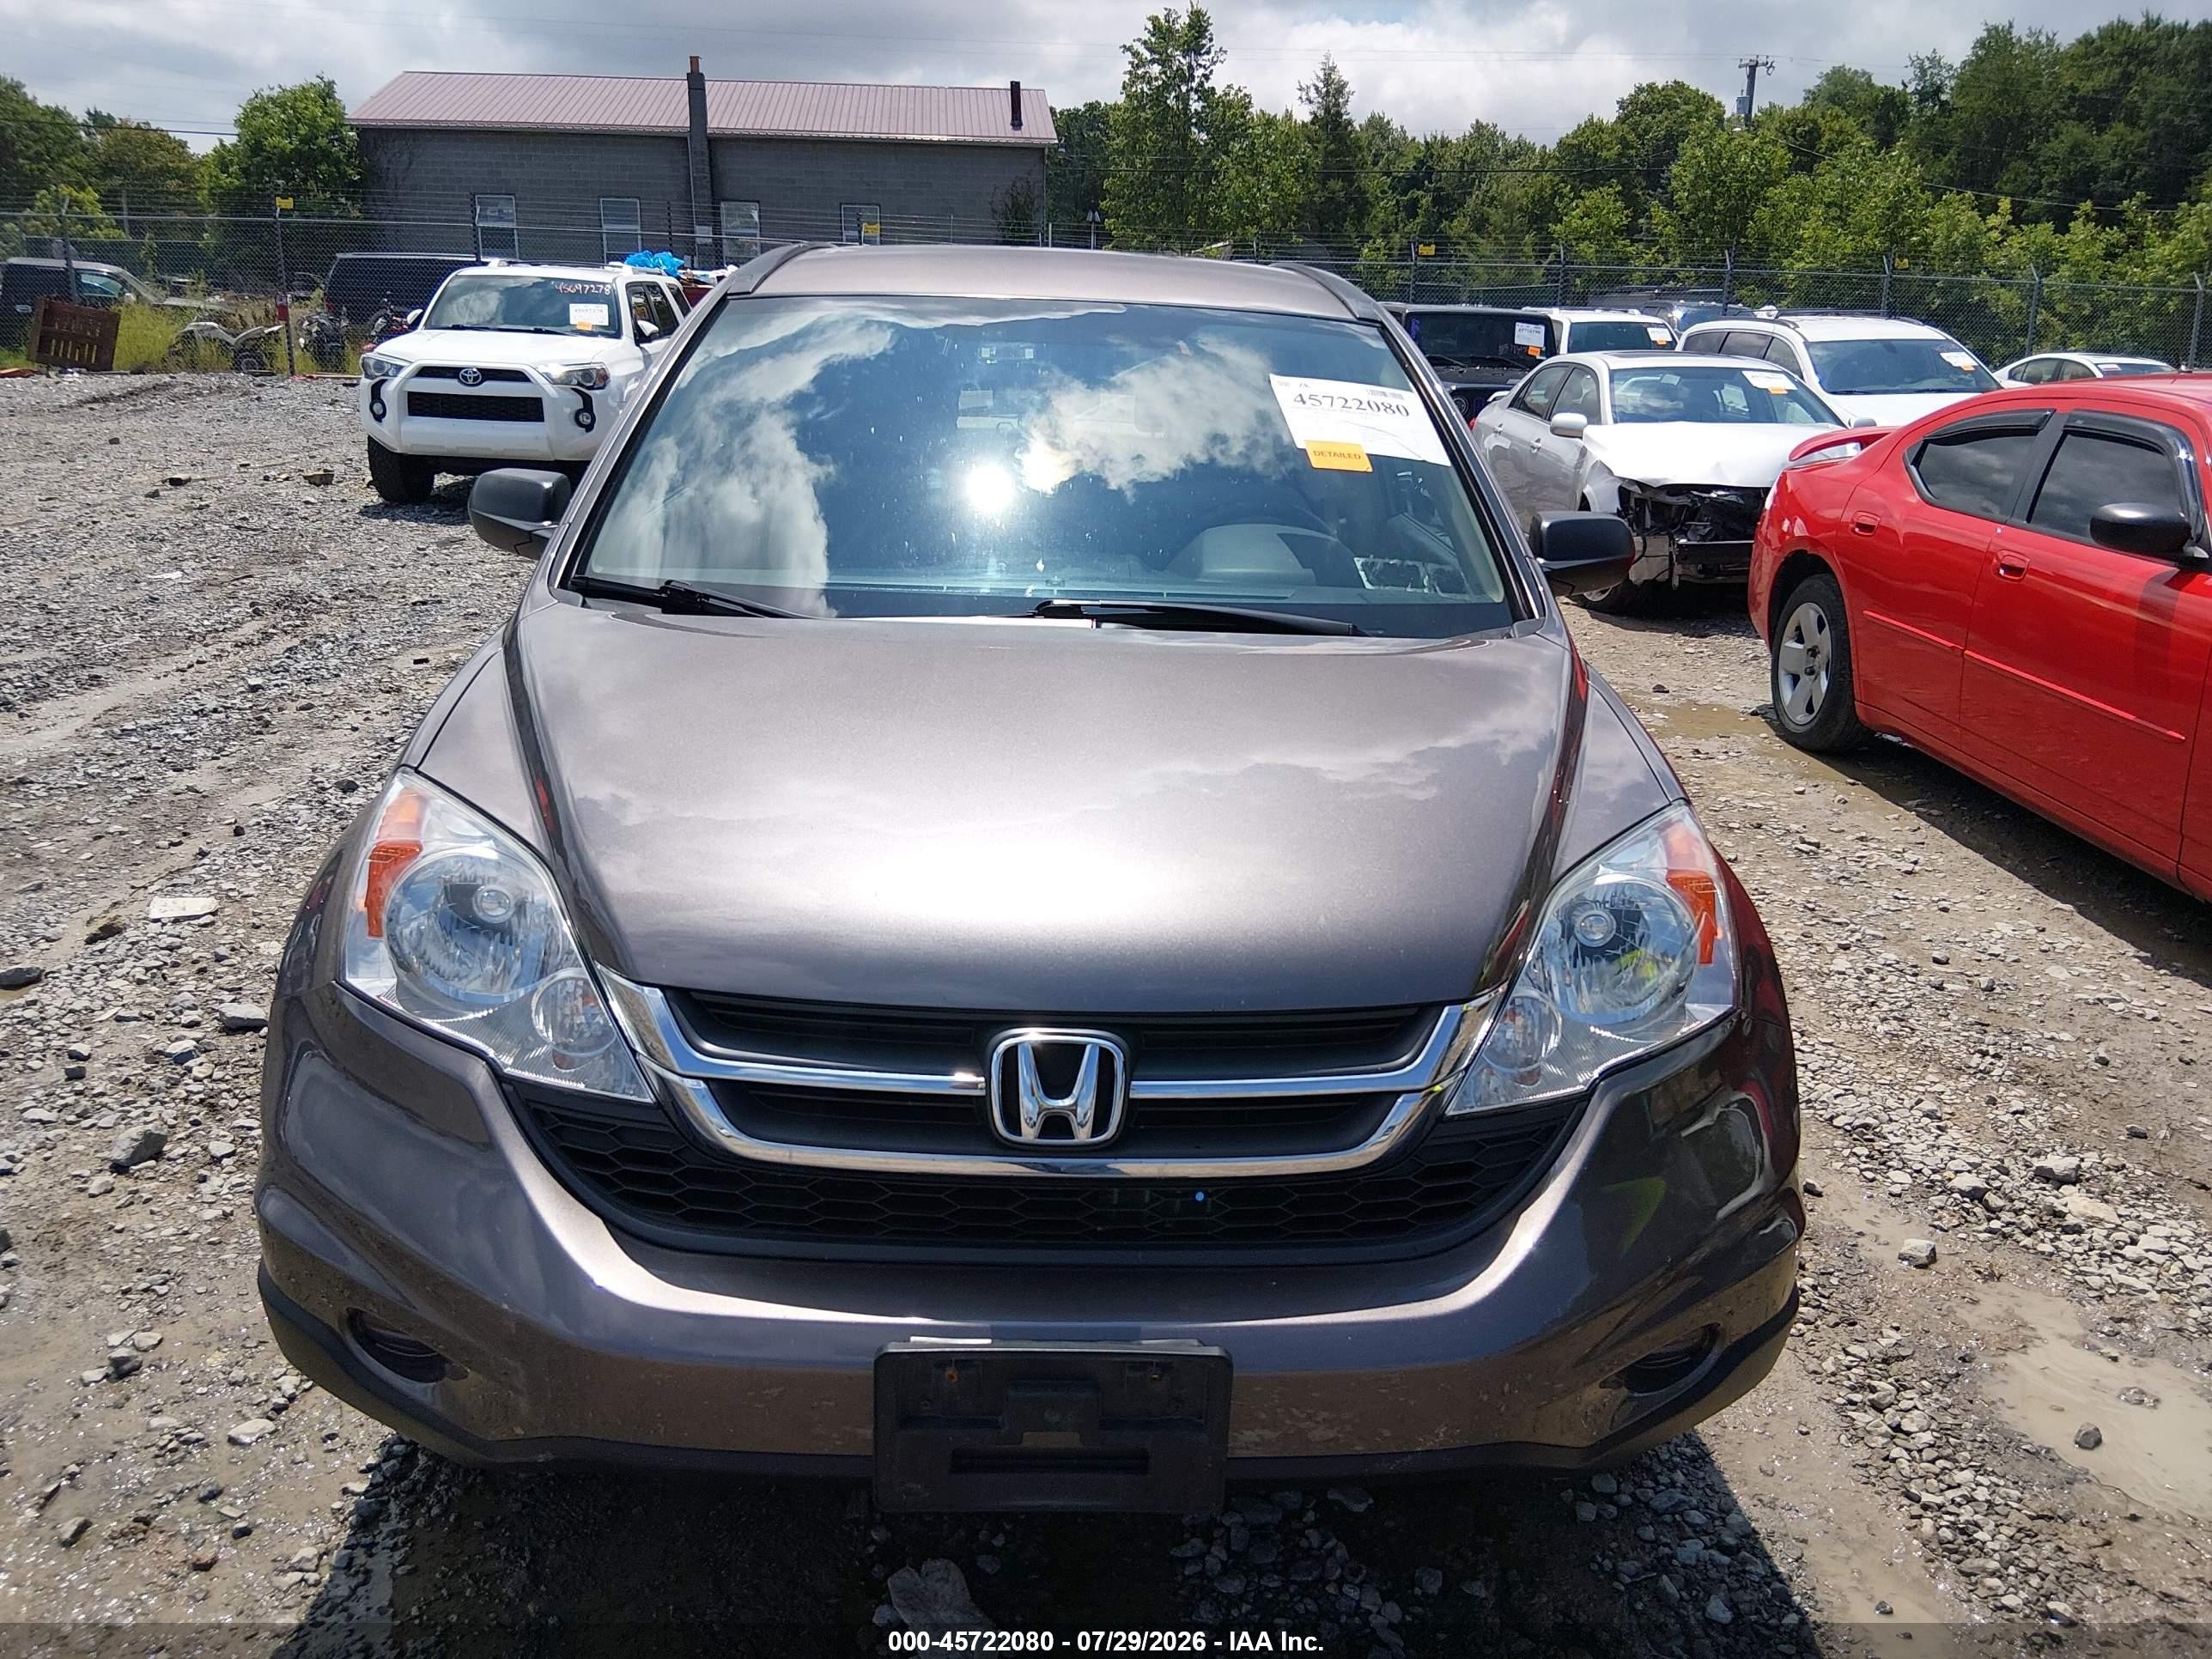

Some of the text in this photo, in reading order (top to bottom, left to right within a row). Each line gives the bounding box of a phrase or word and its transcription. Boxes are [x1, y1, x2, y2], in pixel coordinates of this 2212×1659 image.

[555, 282, 611, 295] 45697278
[1293, 392, 1410, 416] 45722080
[1313, 450, 1361, 460] DETAILED
